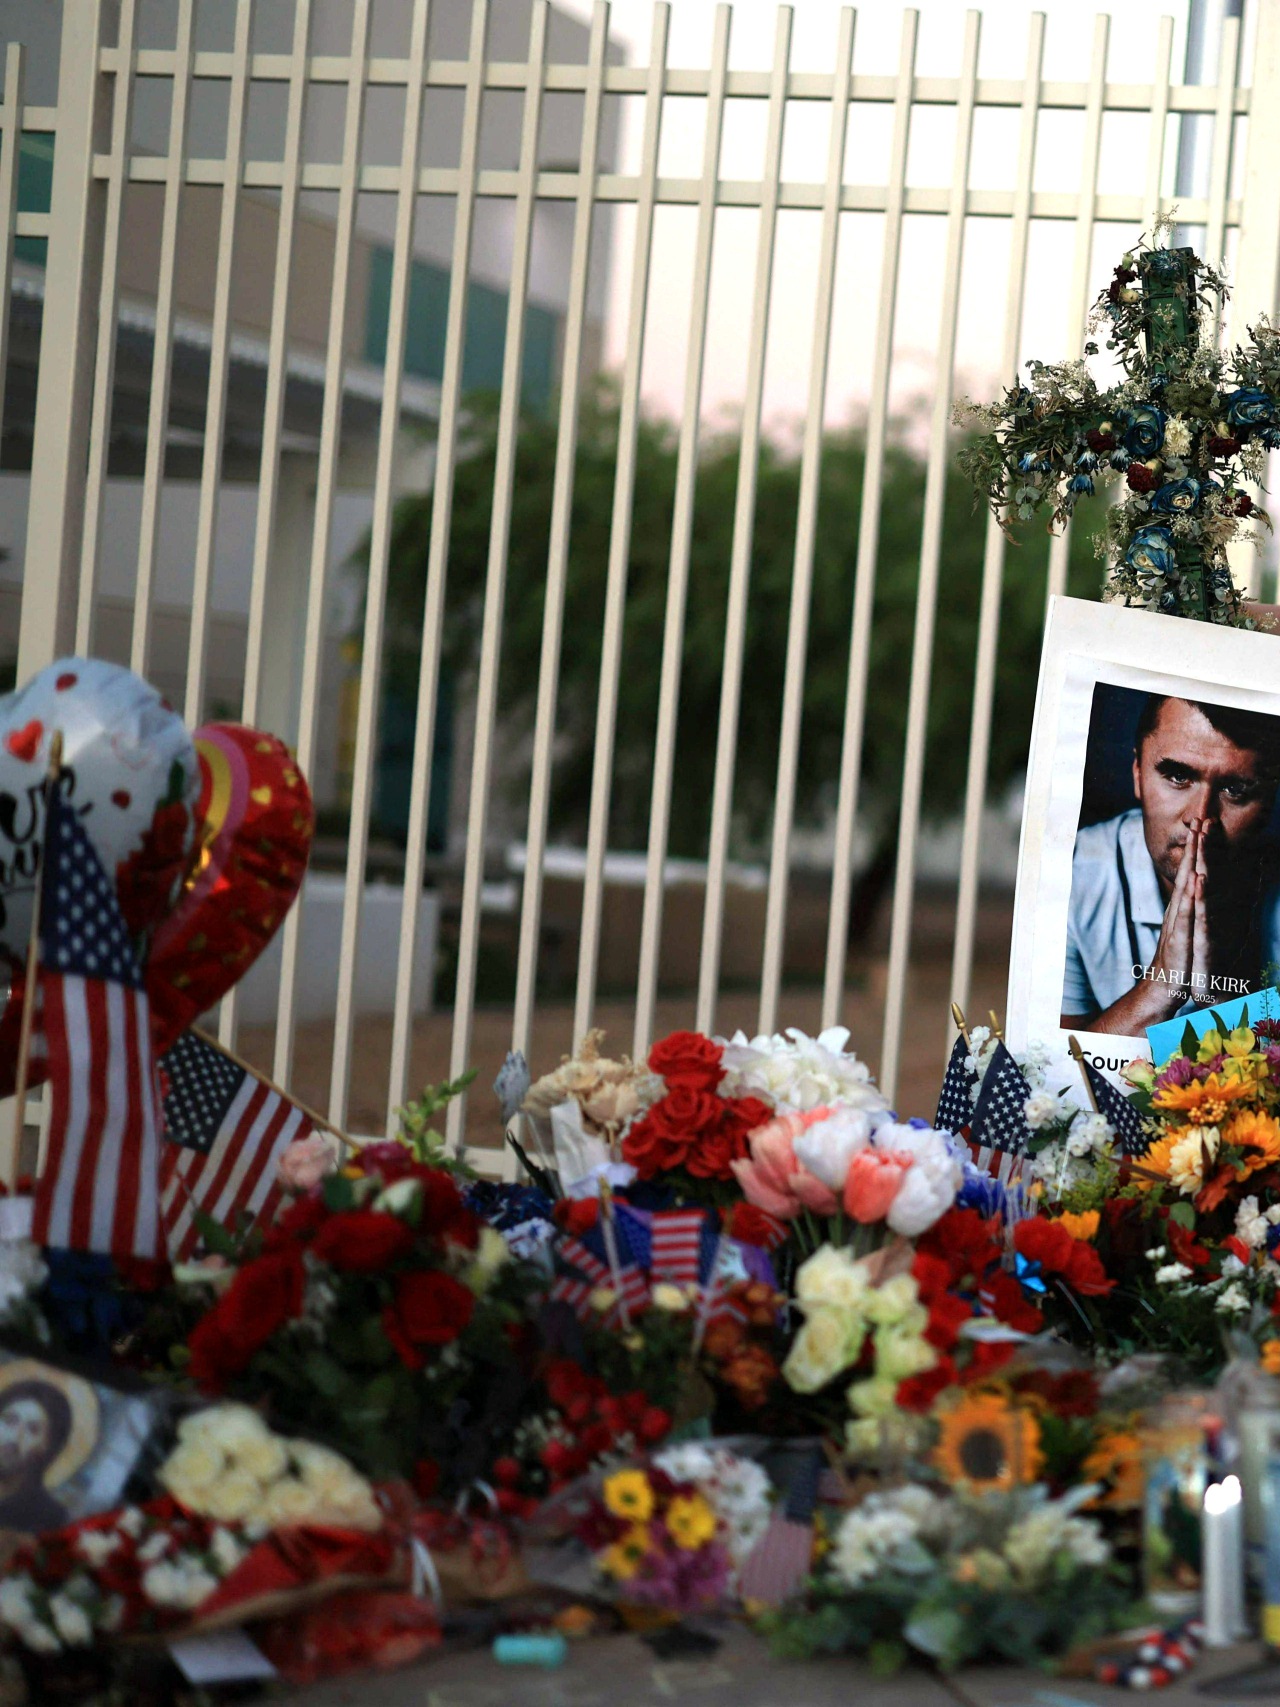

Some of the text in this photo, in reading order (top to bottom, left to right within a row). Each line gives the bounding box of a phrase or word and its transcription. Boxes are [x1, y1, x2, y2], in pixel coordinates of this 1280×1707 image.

[1131, 964, 1251, 994] CHARLIE KIRK
[1168, 989, 1216, 1004] 1993 2025
